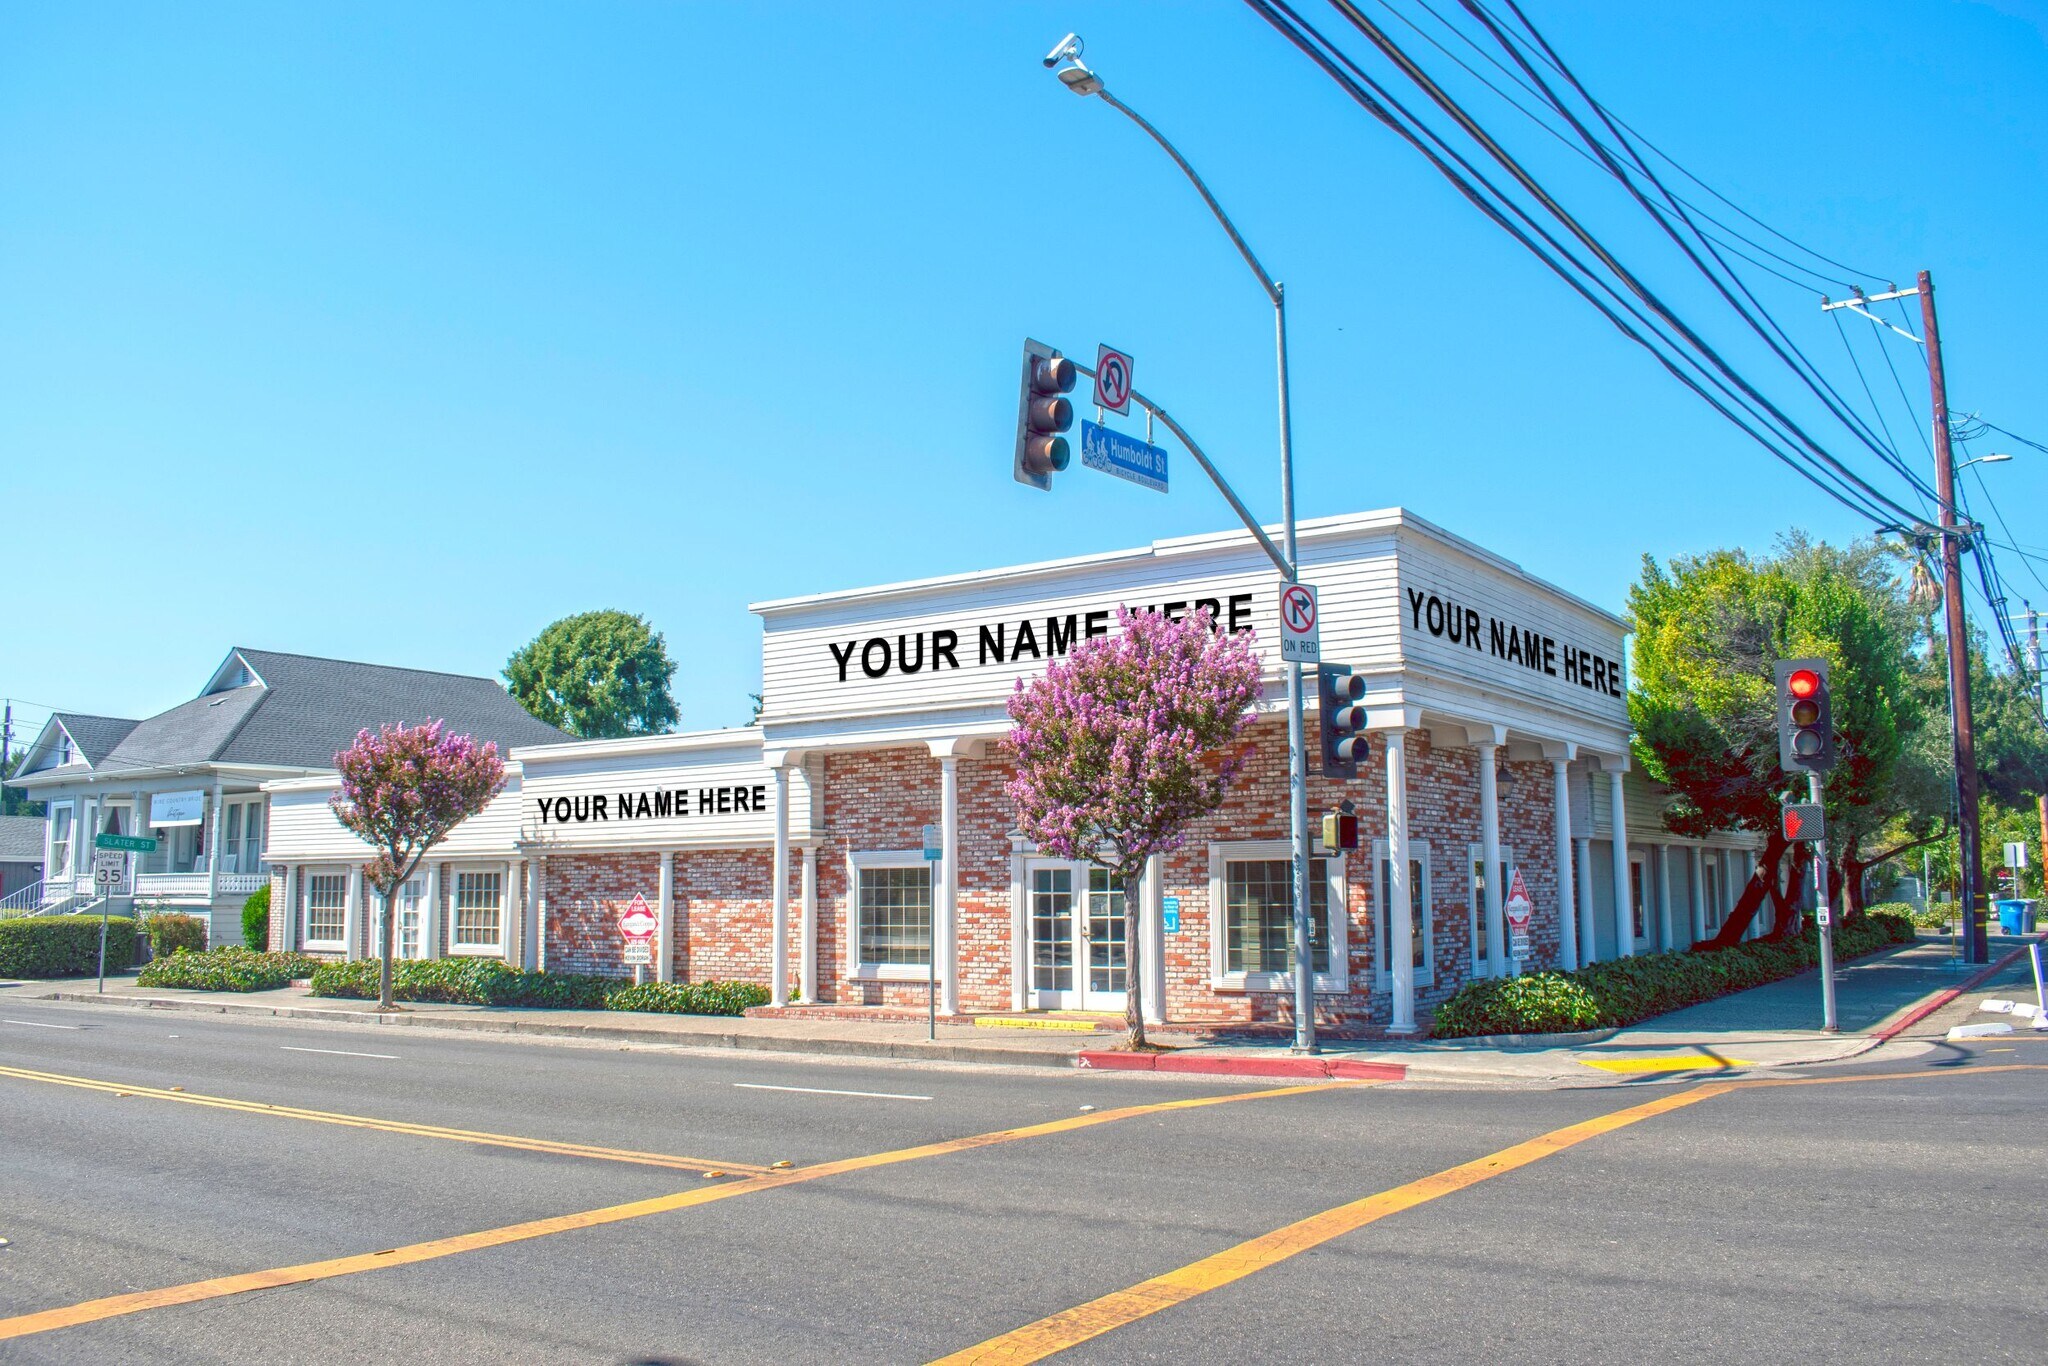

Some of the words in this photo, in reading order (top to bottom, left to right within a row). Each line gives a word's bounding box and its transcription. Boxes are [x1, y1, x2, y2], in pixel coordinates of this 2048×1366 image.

[1110, 437, 1152, 470] Humboldt
[1155, 454, 1167, 475] St.
[1115, 467, 1136, 480] BICYCLE
[1138, 475, 1164, 490] BOULEVARD
[828, 629, 960, 682] YOUR
[1283, 638, 1296, 652] ON
[1300, 640, 1317, 654] RED
[1407, 586, 1482, 652] YOUR
[1490, 617, 1557, 677] NAME
[1563, 644, 1621, 699] HERE
[537, 794, 608, 823] YOUR
[618, 789, 689, 819] NAME
[699, 785, 766, 814] HERE
[104, 837, 135, 848] SLATER
[140, 841, 151, 849] ST
[98, 868, 121, 883] 35
